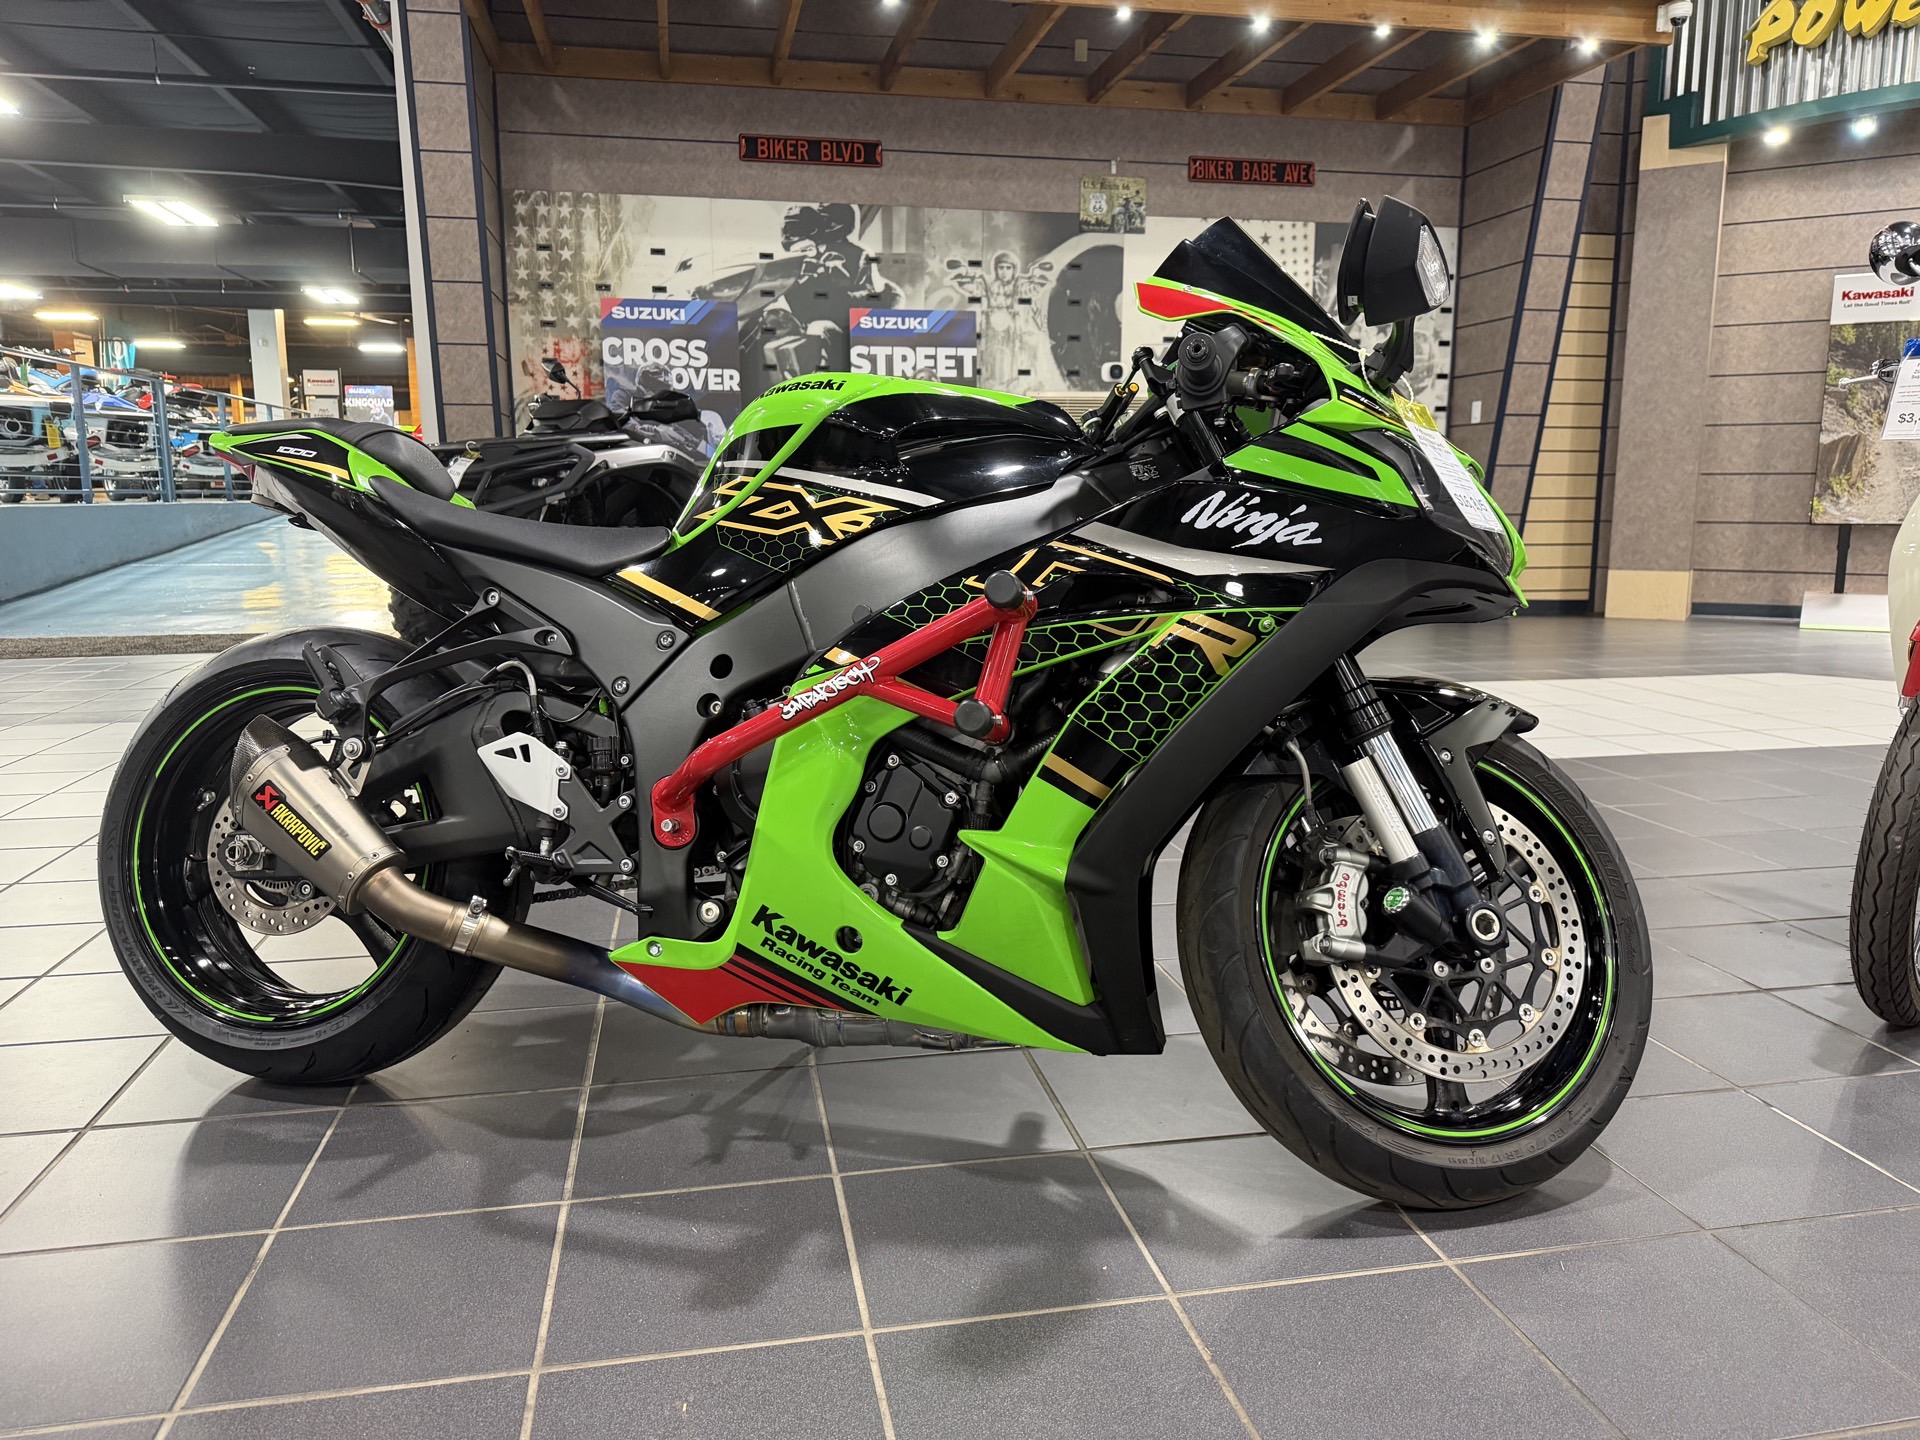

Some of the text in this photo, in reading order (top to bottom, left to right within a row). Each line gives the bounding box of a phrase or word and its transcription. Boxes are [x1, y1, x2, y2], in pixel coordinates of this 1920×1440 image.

[757, 138, 865, 163] BIKER BLVD
[1196, 160, 1308, 183] BIKER BABE AVE
[1092, 204, 1104, 212] 66
[1841, 286, 1915, 301] Kawasaki
[611, 306, 686, 321] SUZUKI
[859, 316, 928, 330] SUZUKI
[602, 337, 709, 367] CROSS
[850, 345, 978, 378] STREET
[672, 367, 741, 391] OVER
[345, 397, 394, 407] KINGQUAD
[1897, 412, 1920, 425] $3,
[277, 445, 317, 458] 1000
[1181, 490, 1323, 549] Ninja
[1535, 771, 1629, 901] MICHELIN
[1336, 873, 1351, 927] brembo
[750, 904, 913, 1007] Kawasaki
[760, 936, 881, 1007] Racing Team
